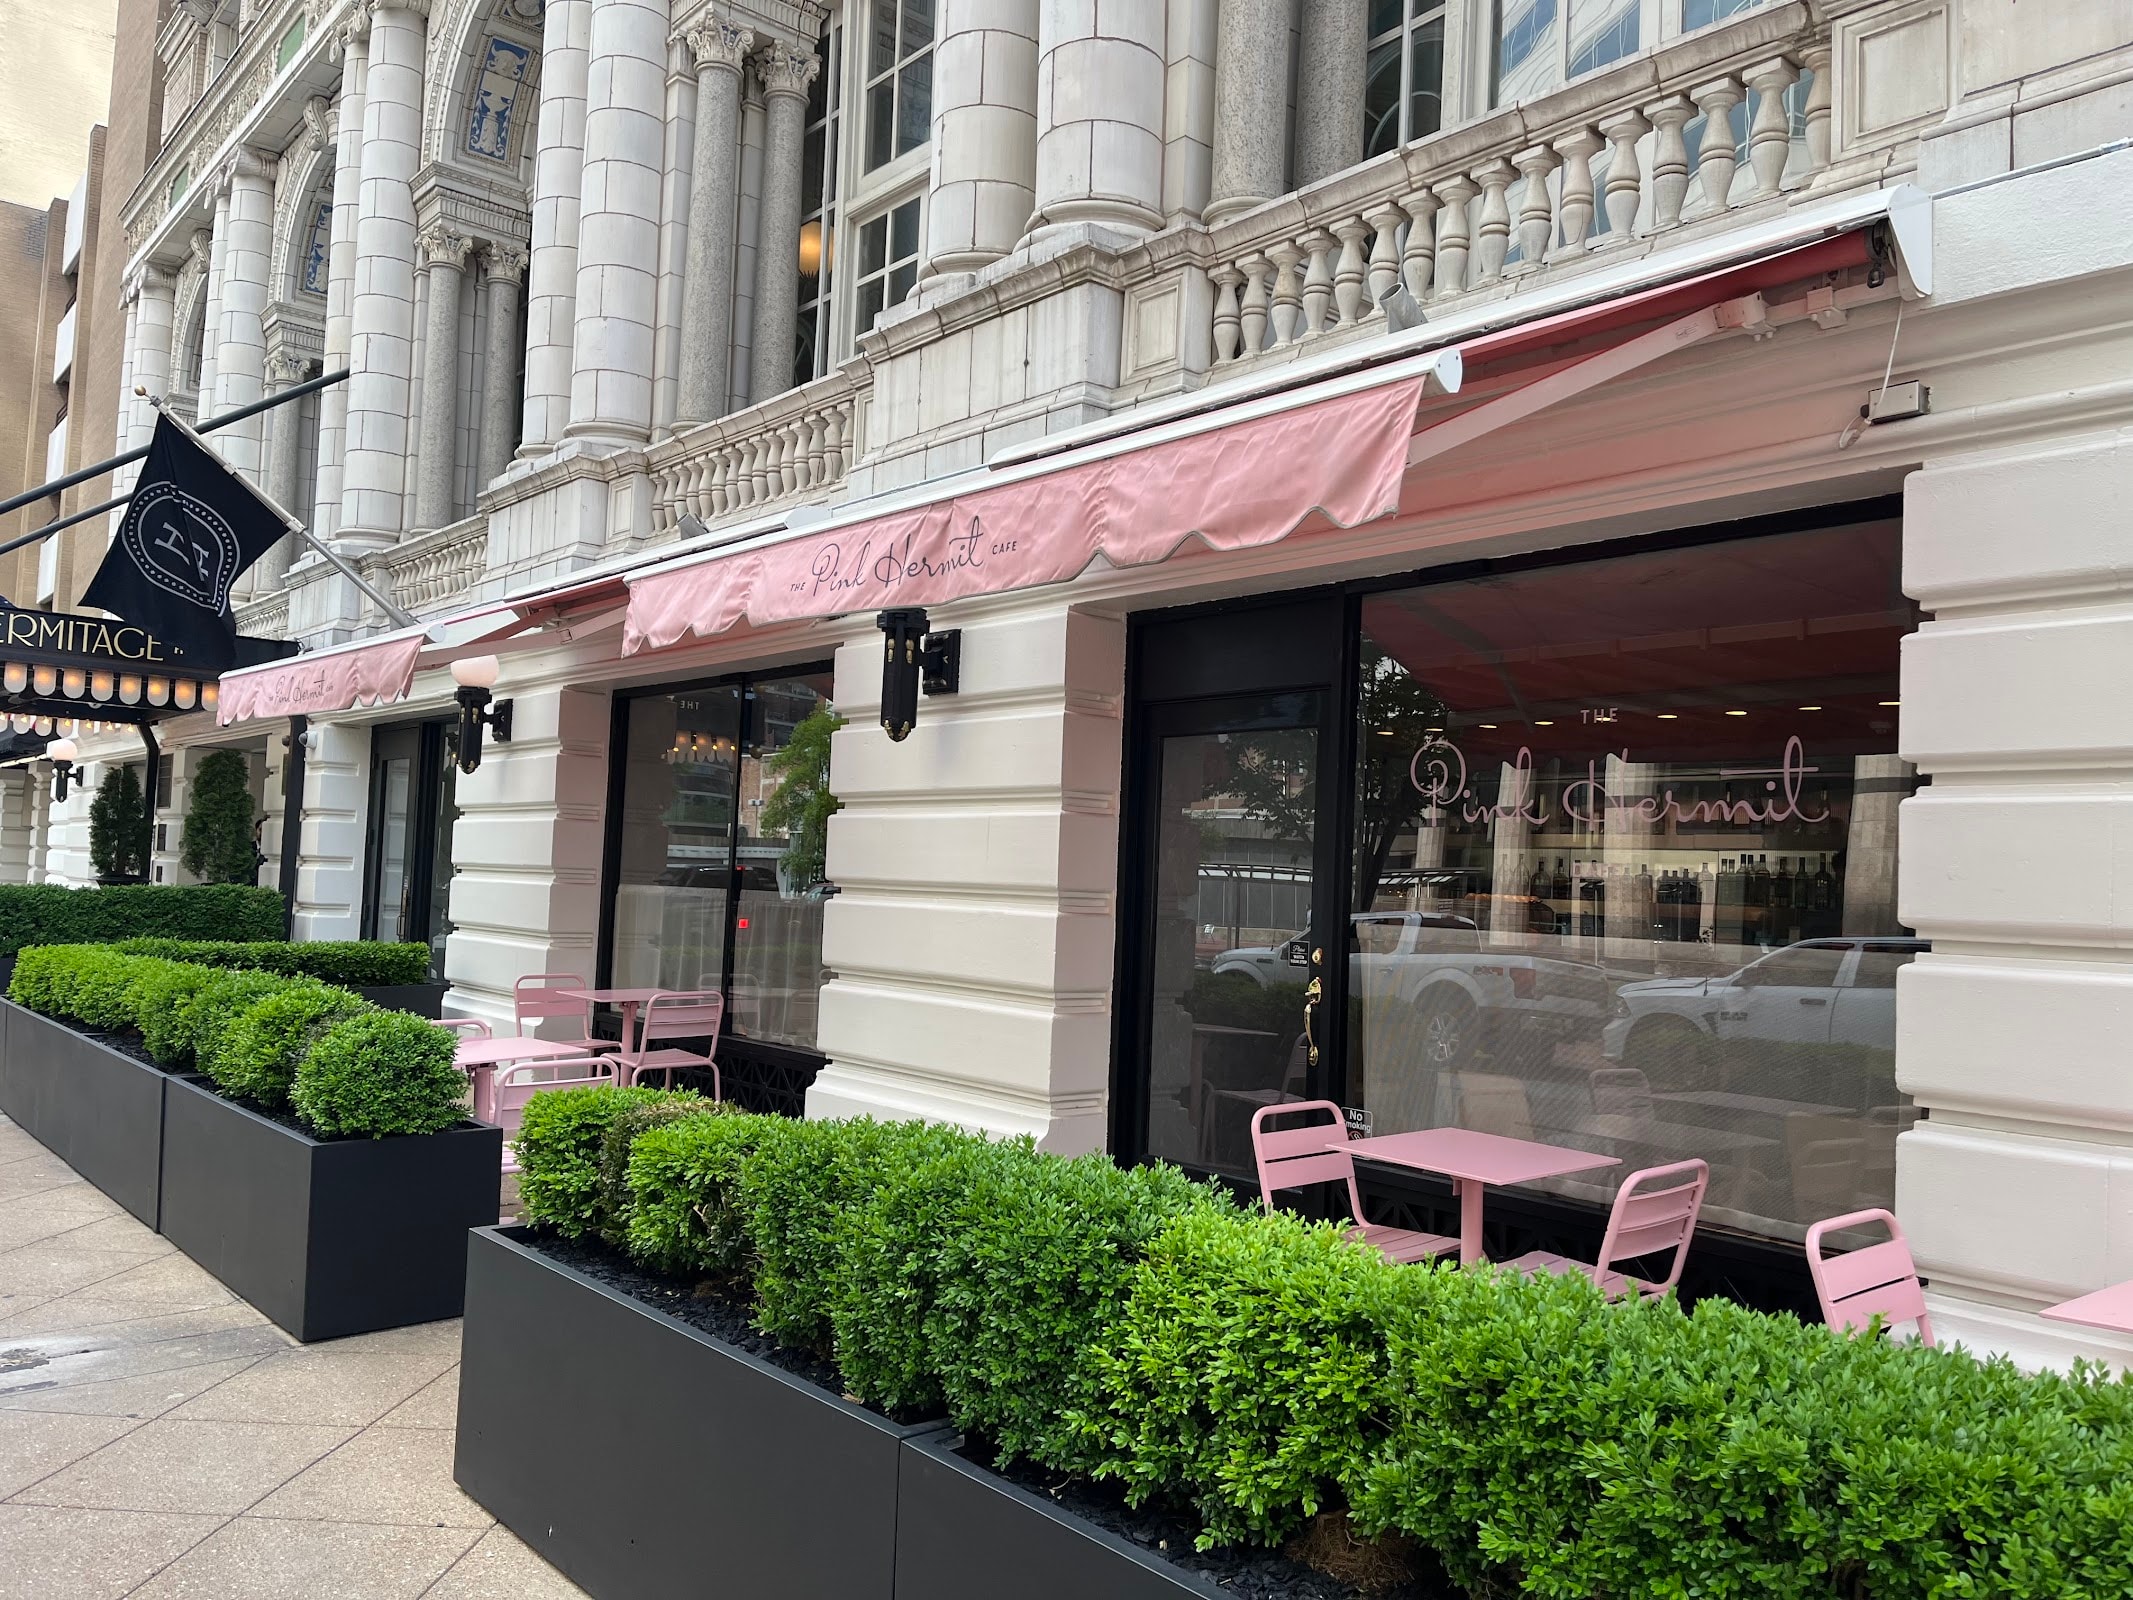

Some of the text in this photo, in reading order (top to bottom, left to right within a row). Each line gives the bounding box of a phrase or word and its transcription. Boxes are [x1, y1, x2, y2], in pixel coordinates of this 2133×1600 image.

[790, 515, 1018, 597] THE Pink Hermit CAFE
[1580, 707, 1619, 724] THE
[1410, 734, 1830, 833] Pink Hermit
[1349, 1110, 1363, 1121] No
[1346, 1121, 1371, 1133] moking
